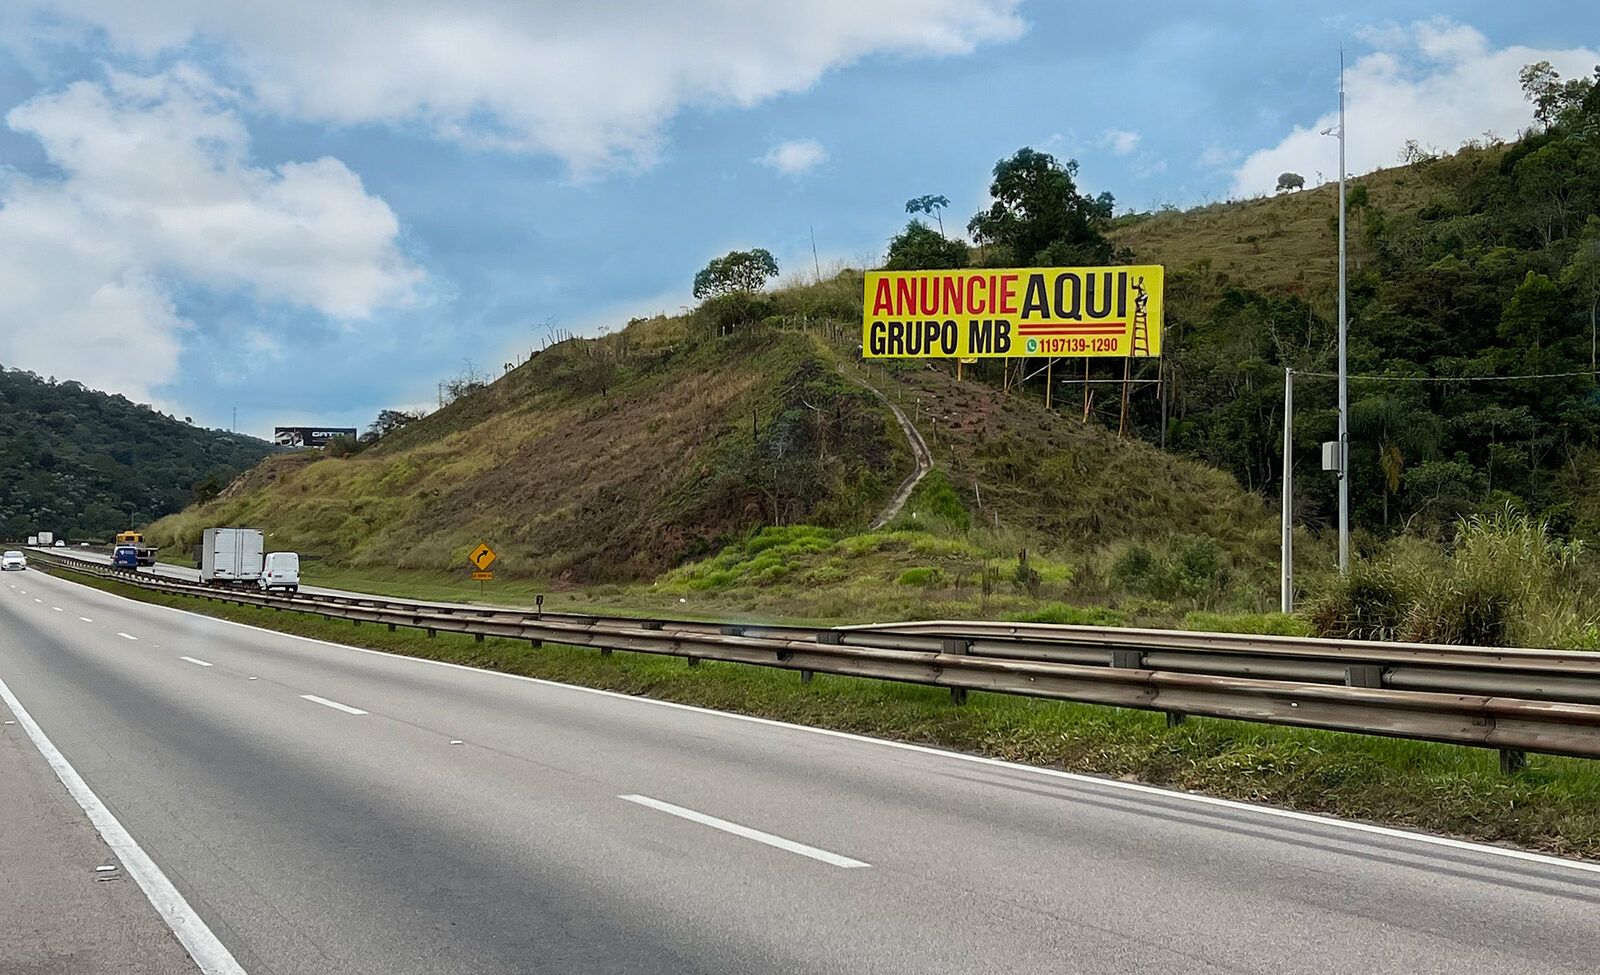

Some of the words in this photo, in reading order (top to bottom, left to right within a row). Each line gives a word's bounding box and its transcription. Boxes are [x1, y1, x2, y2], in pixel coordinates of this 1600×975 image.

[872, 275, 1019, 316] ANUNCIE
[1021, 271, 1127, 321] AQUI
[870, 320, 958, 355] GRUPO
[968, 320, 1011, 354] MB
[1039, 337, 1118, 353] 1197139-1290
